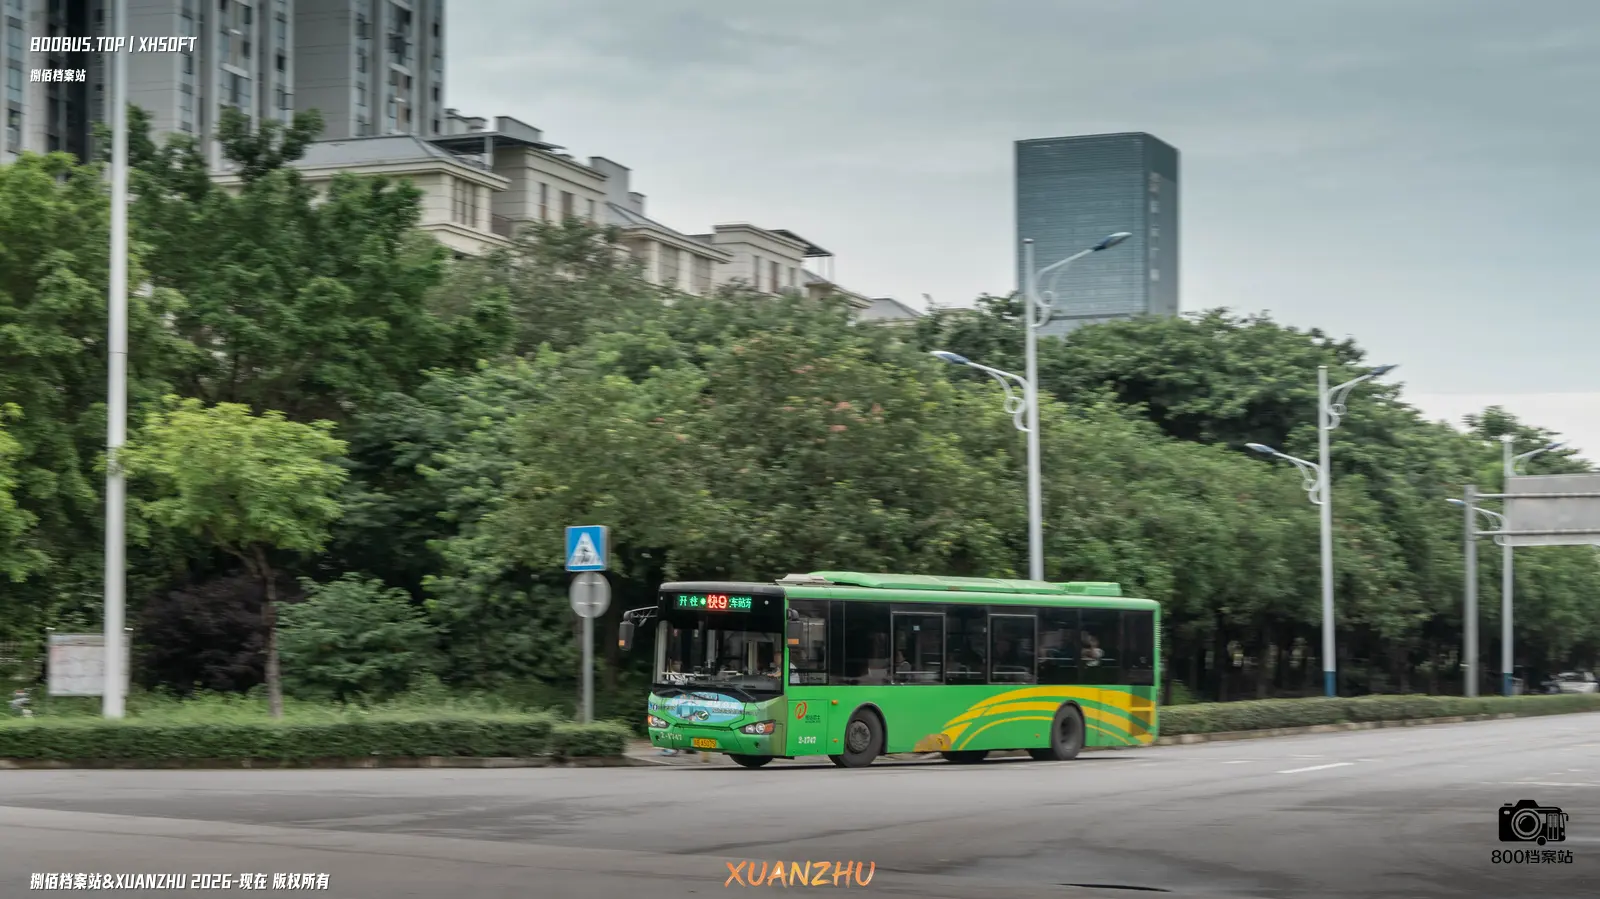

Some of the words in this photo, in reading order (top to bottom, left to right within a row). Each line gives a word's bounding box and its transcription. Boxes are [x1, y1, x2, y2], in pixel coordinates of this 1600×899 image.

[680, 595, 698, 607] 开往
[707, 594, 727, 609] 快9
[798, 736, 816, 744] 2-1747
